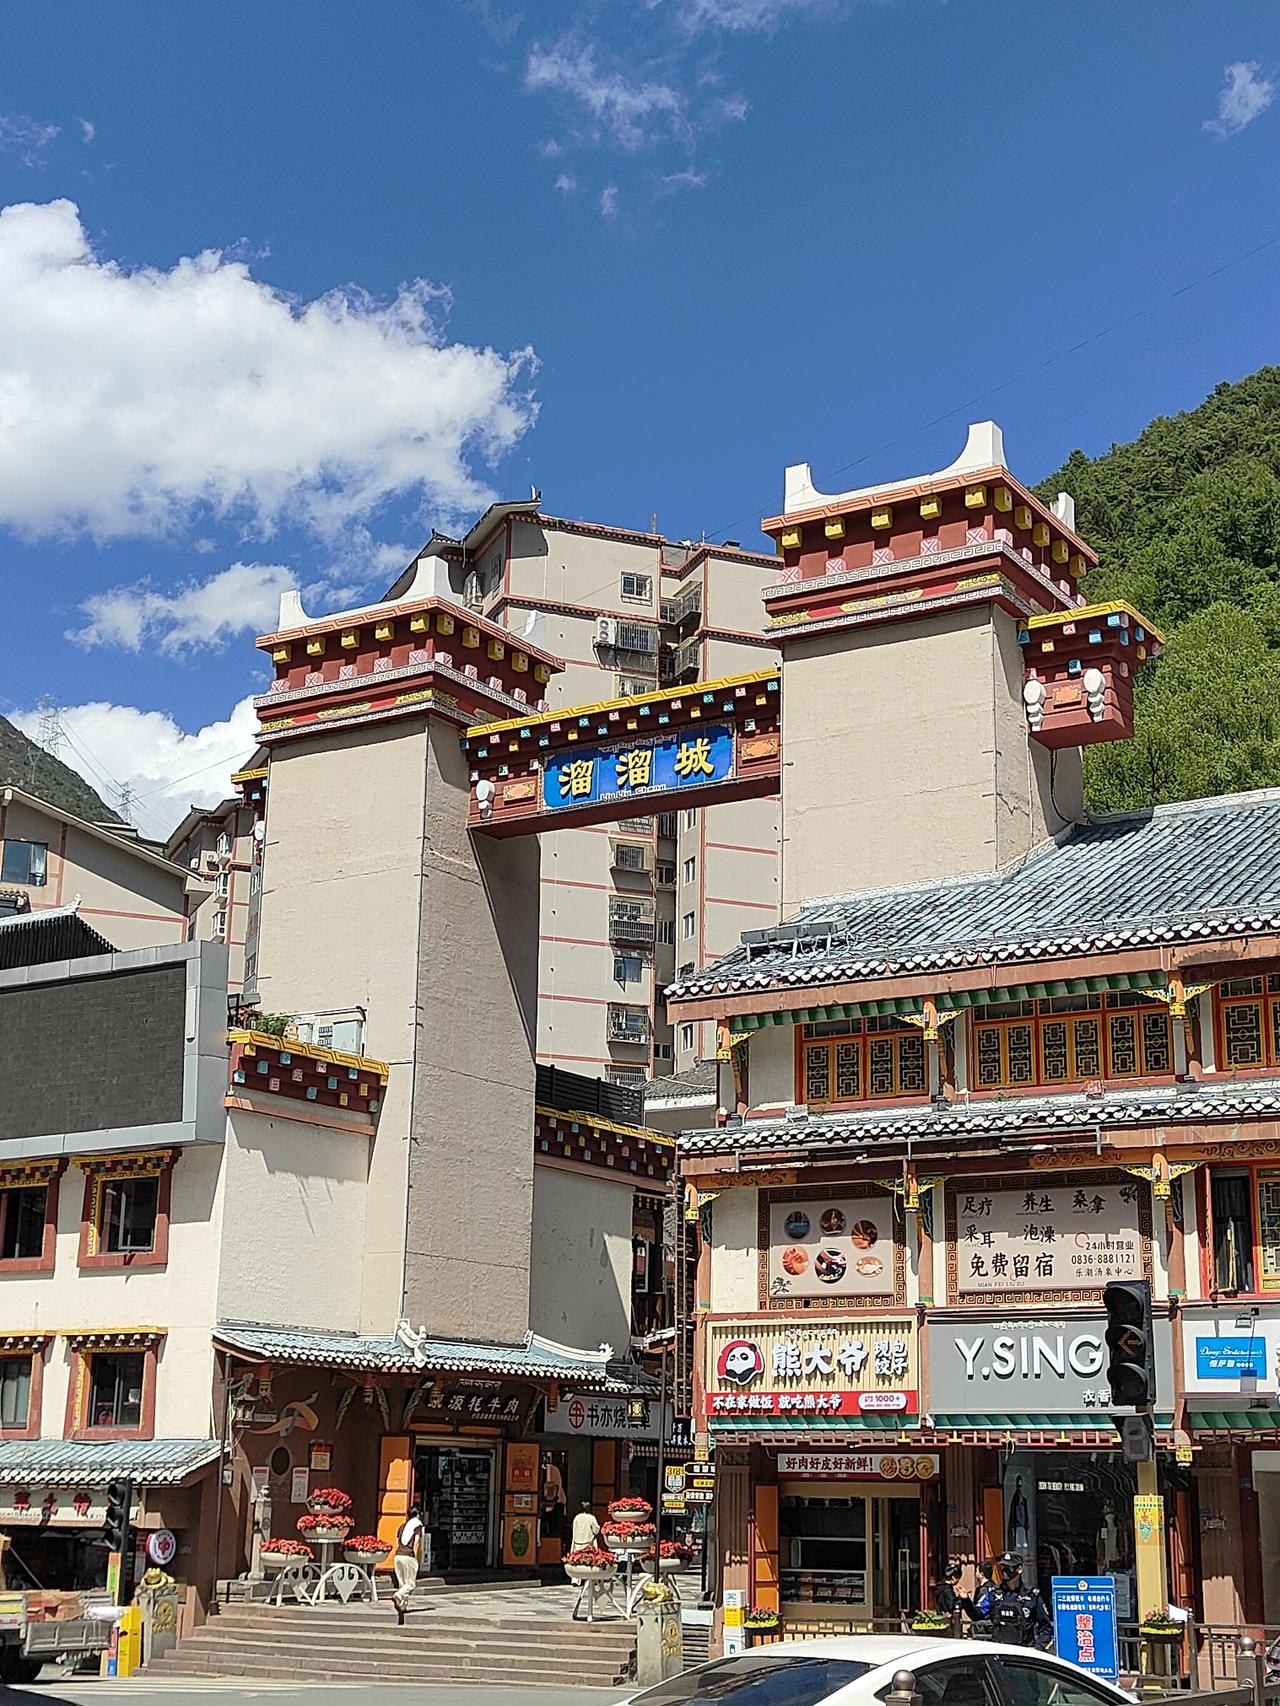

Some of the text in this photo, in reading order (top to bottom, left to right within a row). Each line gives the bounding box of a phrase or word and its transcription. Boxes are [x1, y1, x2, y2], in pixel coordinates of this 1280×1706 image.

[558, 738, 714, 796] 溜溜城
[962, 1196, 992, 1216] 足疗
[1022, 1191, 1055, 1213] 养生
[1072, 1189, 1107, 1214] 桑拿
[964, 1224, 995, 1248] 采耳
[1023, 1223, 1056, 1243] 泡澡
[1085, 1240, 1134, 1251] 24小时营业
[969, 1252, 1054, 1279] 免费留宿
[1071, 1253, 1135, 1265] 0836-8881121
[772, 1341, 868, 1377] 熊大爷
[875, 1341, 907, 1358] 现包
[954, 1335, 1103, 1377] Y.SING
[875, 1357, 907, 1376] 饺子
[712, 1393, 841, 1410] 不在家做饭 就吃熊大爷
[1075, 1613, 1096, 1663] 整治点
